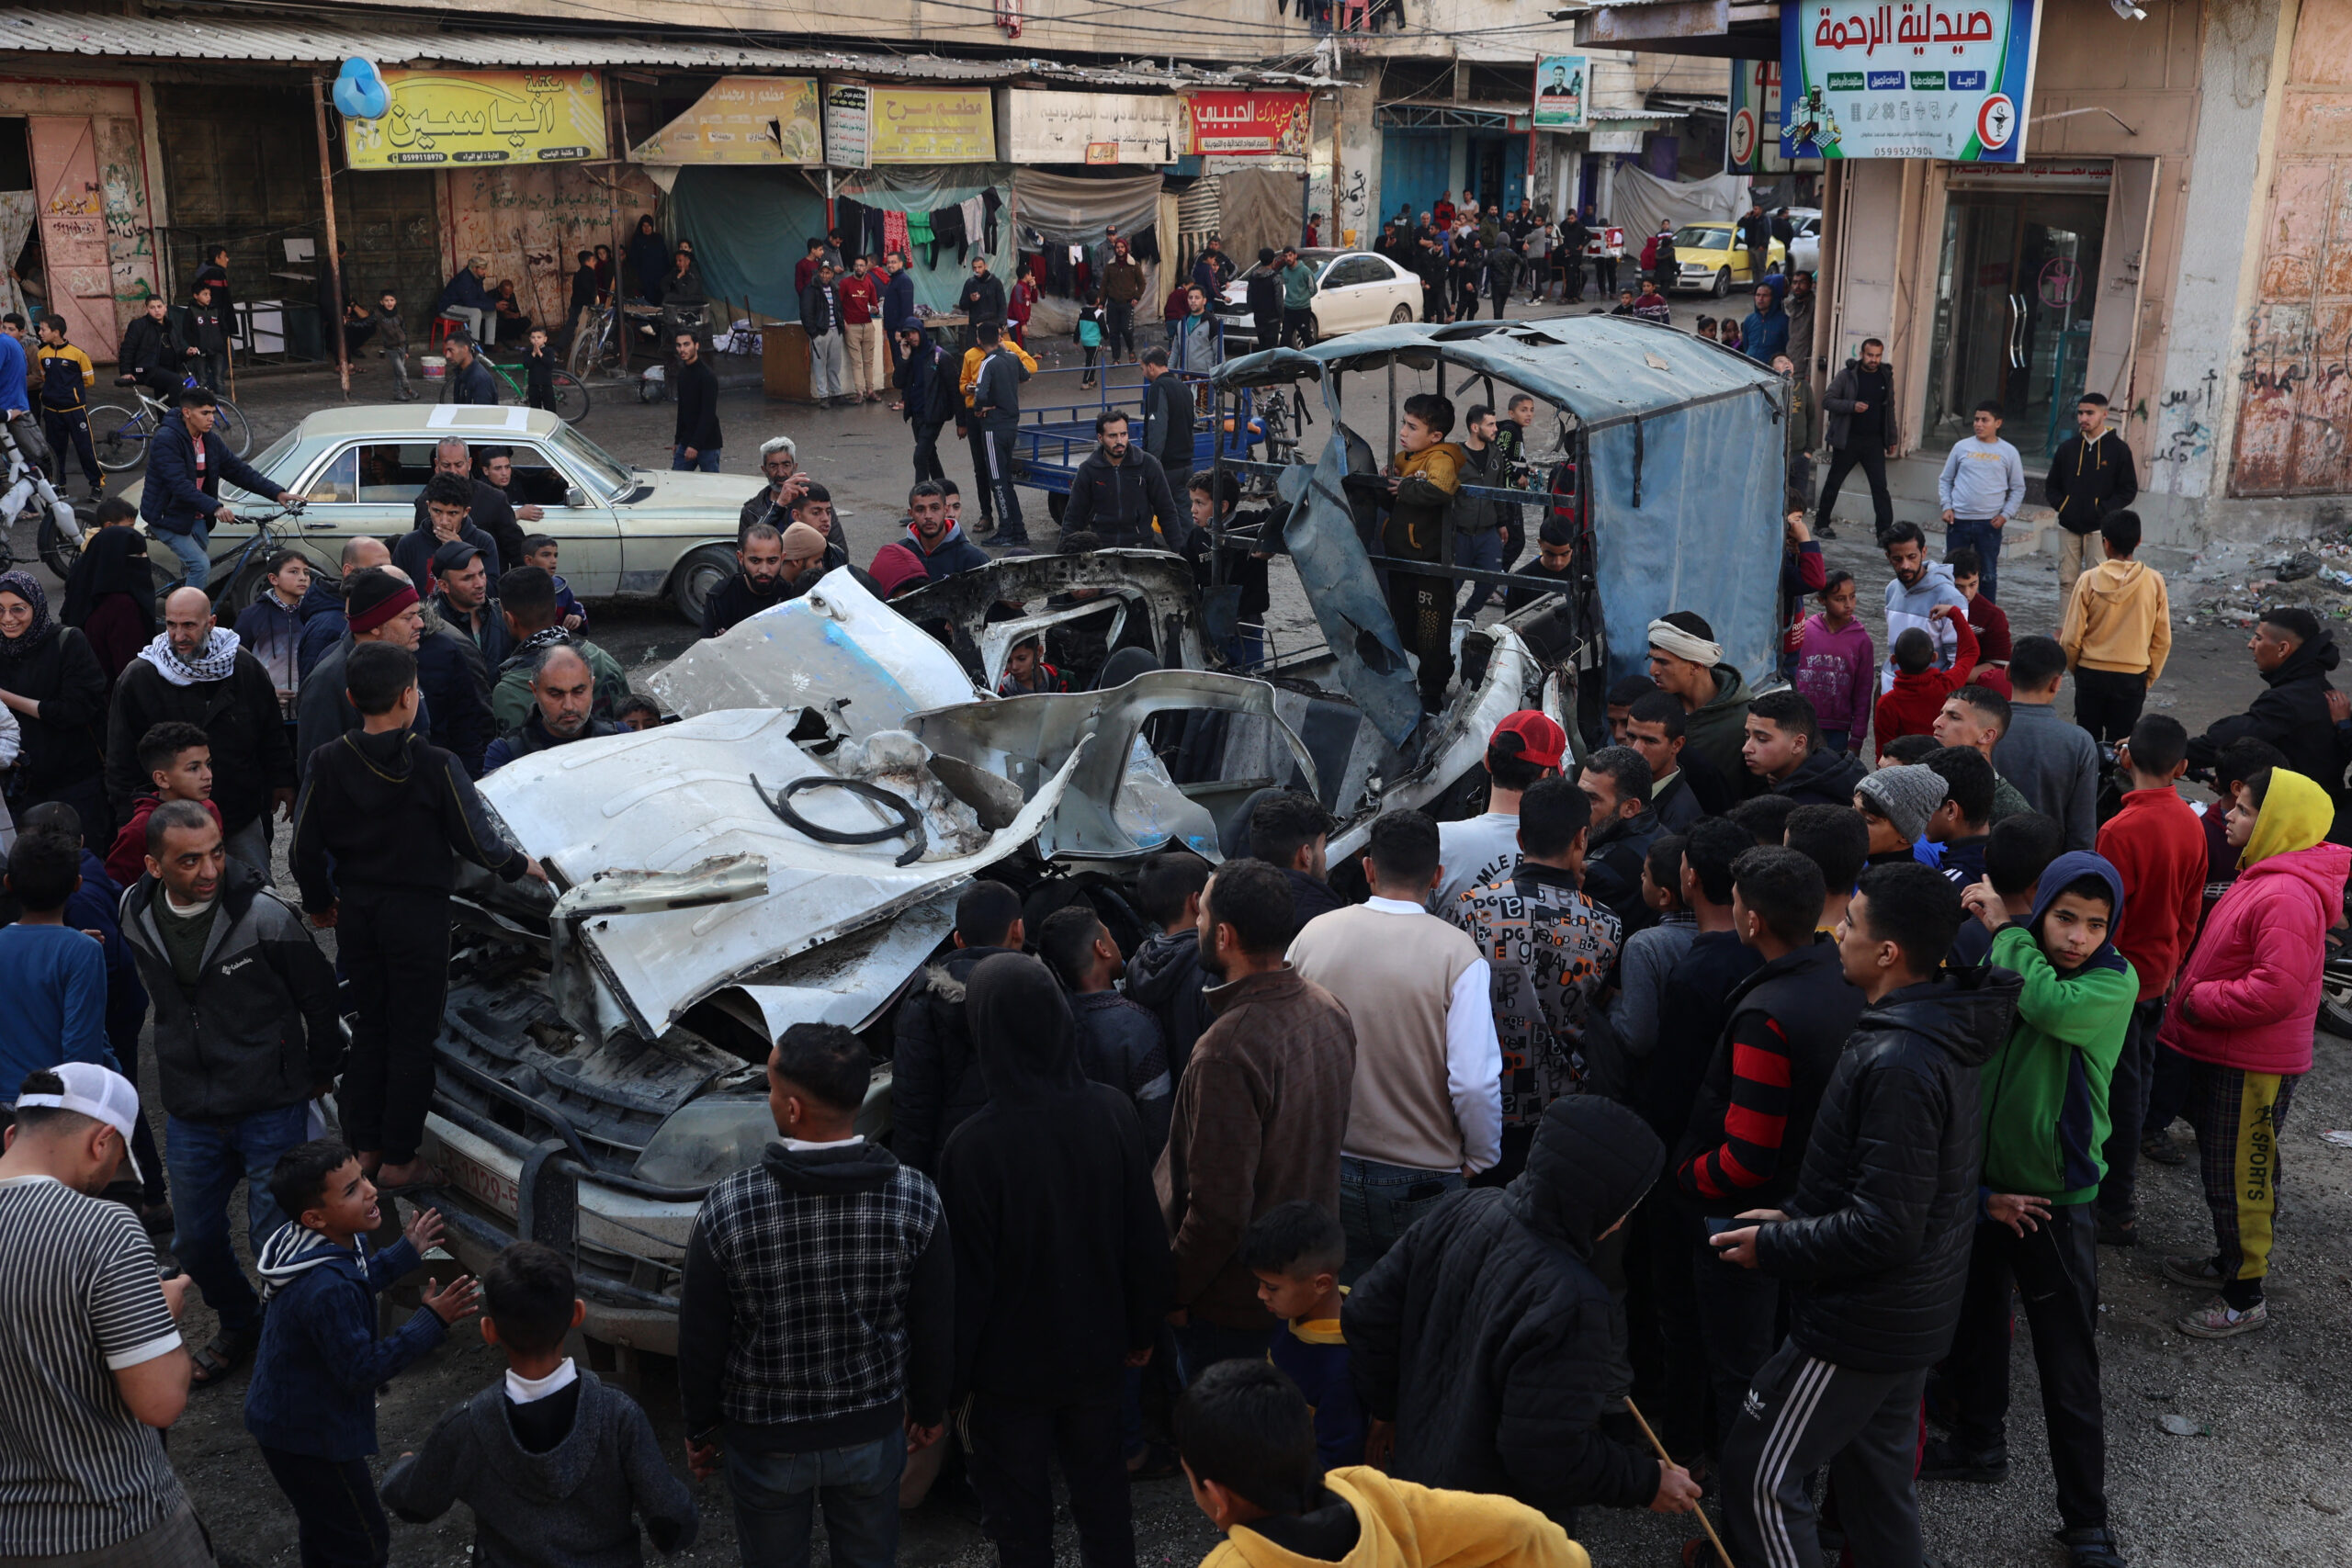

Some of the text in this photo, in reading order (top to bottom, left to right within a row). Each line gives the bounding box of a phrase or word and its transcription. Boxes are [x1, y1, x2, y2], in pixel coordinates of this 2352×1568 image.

[1815, 3, 1993, 57] صيدلية الرحمة
[526, 73, 564, 96] مكتبة
[1956, 72, 1978, 87] أدوية
[707, 86, 785, 106] مطعم و مجمدات
[935, 96, 982, 118] مطعم
[886, 98, 933, 120] مرح
[1196, 100, 1255, 130] الحبيبي
[387, 96, 555, 148] الياسين
[401, 152, 444, 162] 0599118970
[2049, 166, 2087, 176] محمد
[1418, 590, 1433, 606] BR
[230, 956, 254, 970] Columbia
[2247, 1131, 2270, 1201] SPORTS
